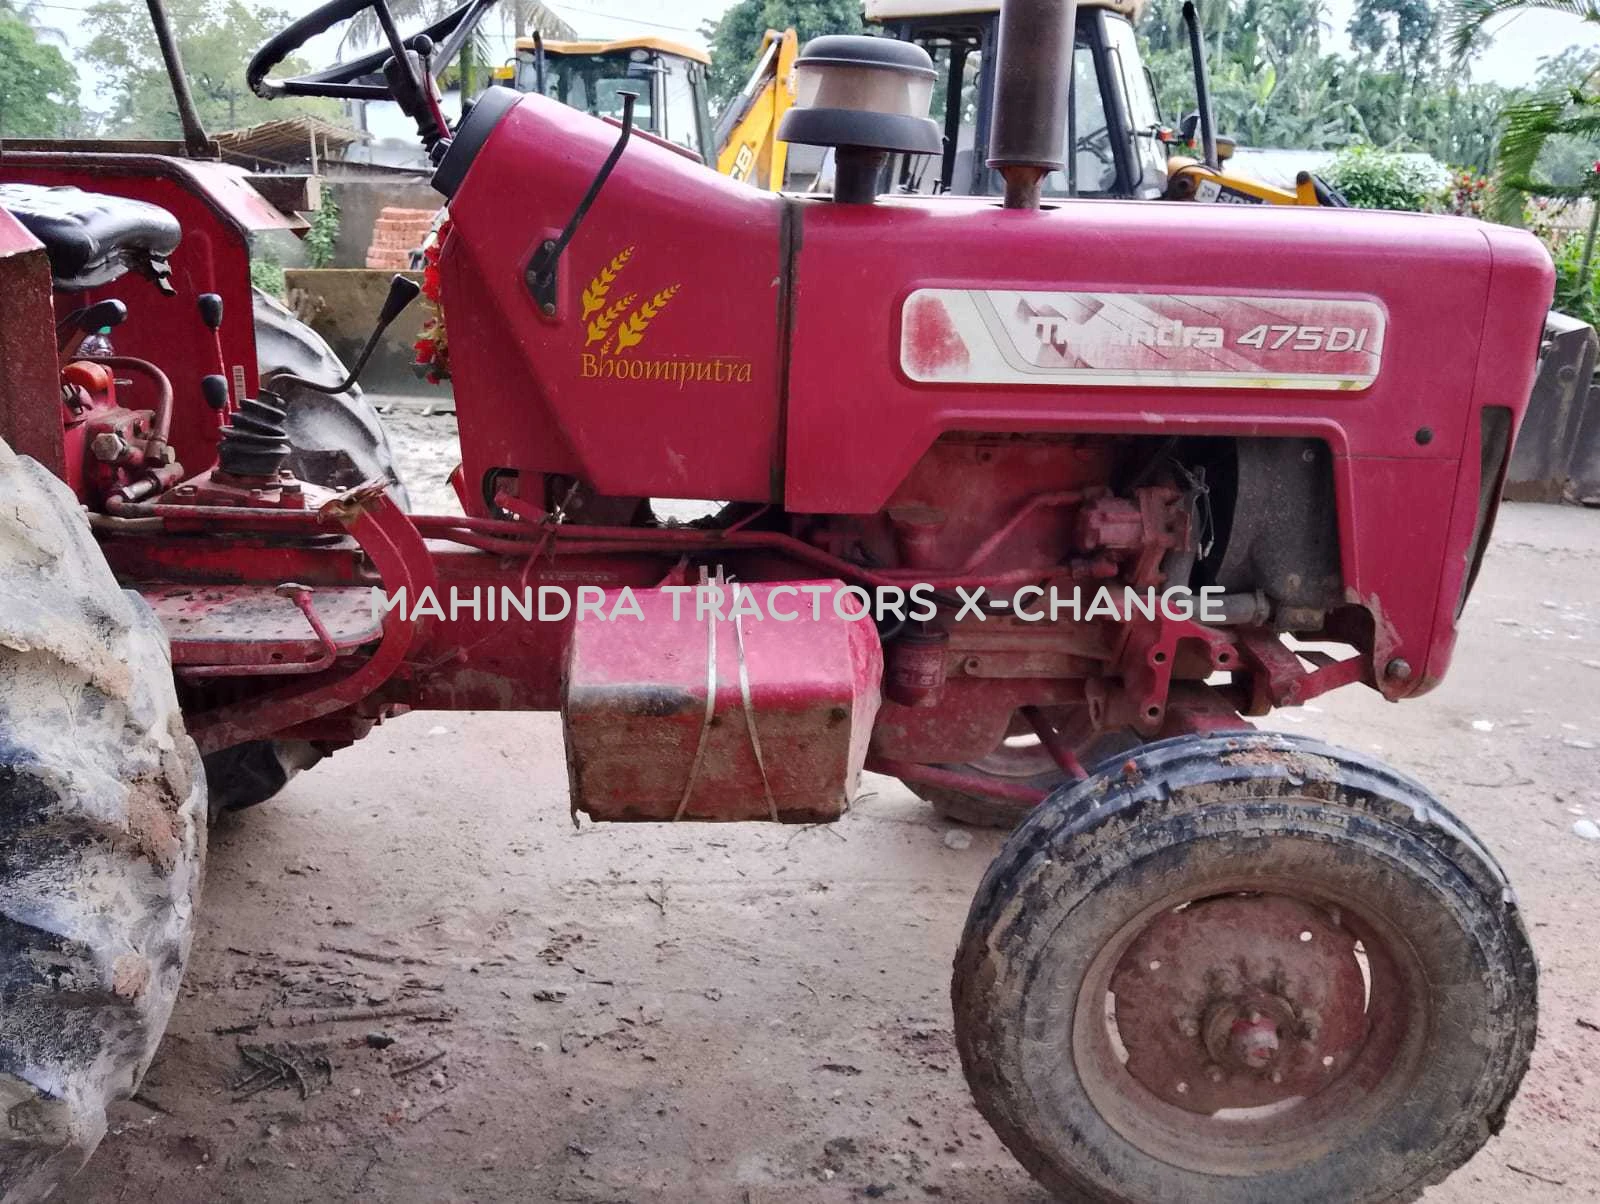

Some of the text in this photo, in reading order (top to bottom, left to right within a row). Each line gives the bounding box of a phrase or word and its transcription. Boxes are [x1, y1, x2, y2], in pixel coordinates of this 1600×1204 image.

[729, 144, 754, 182] CB
[1237, 324, 1369, 352] 475DI
[580, 352, 752, 391] Bhoomiputra
